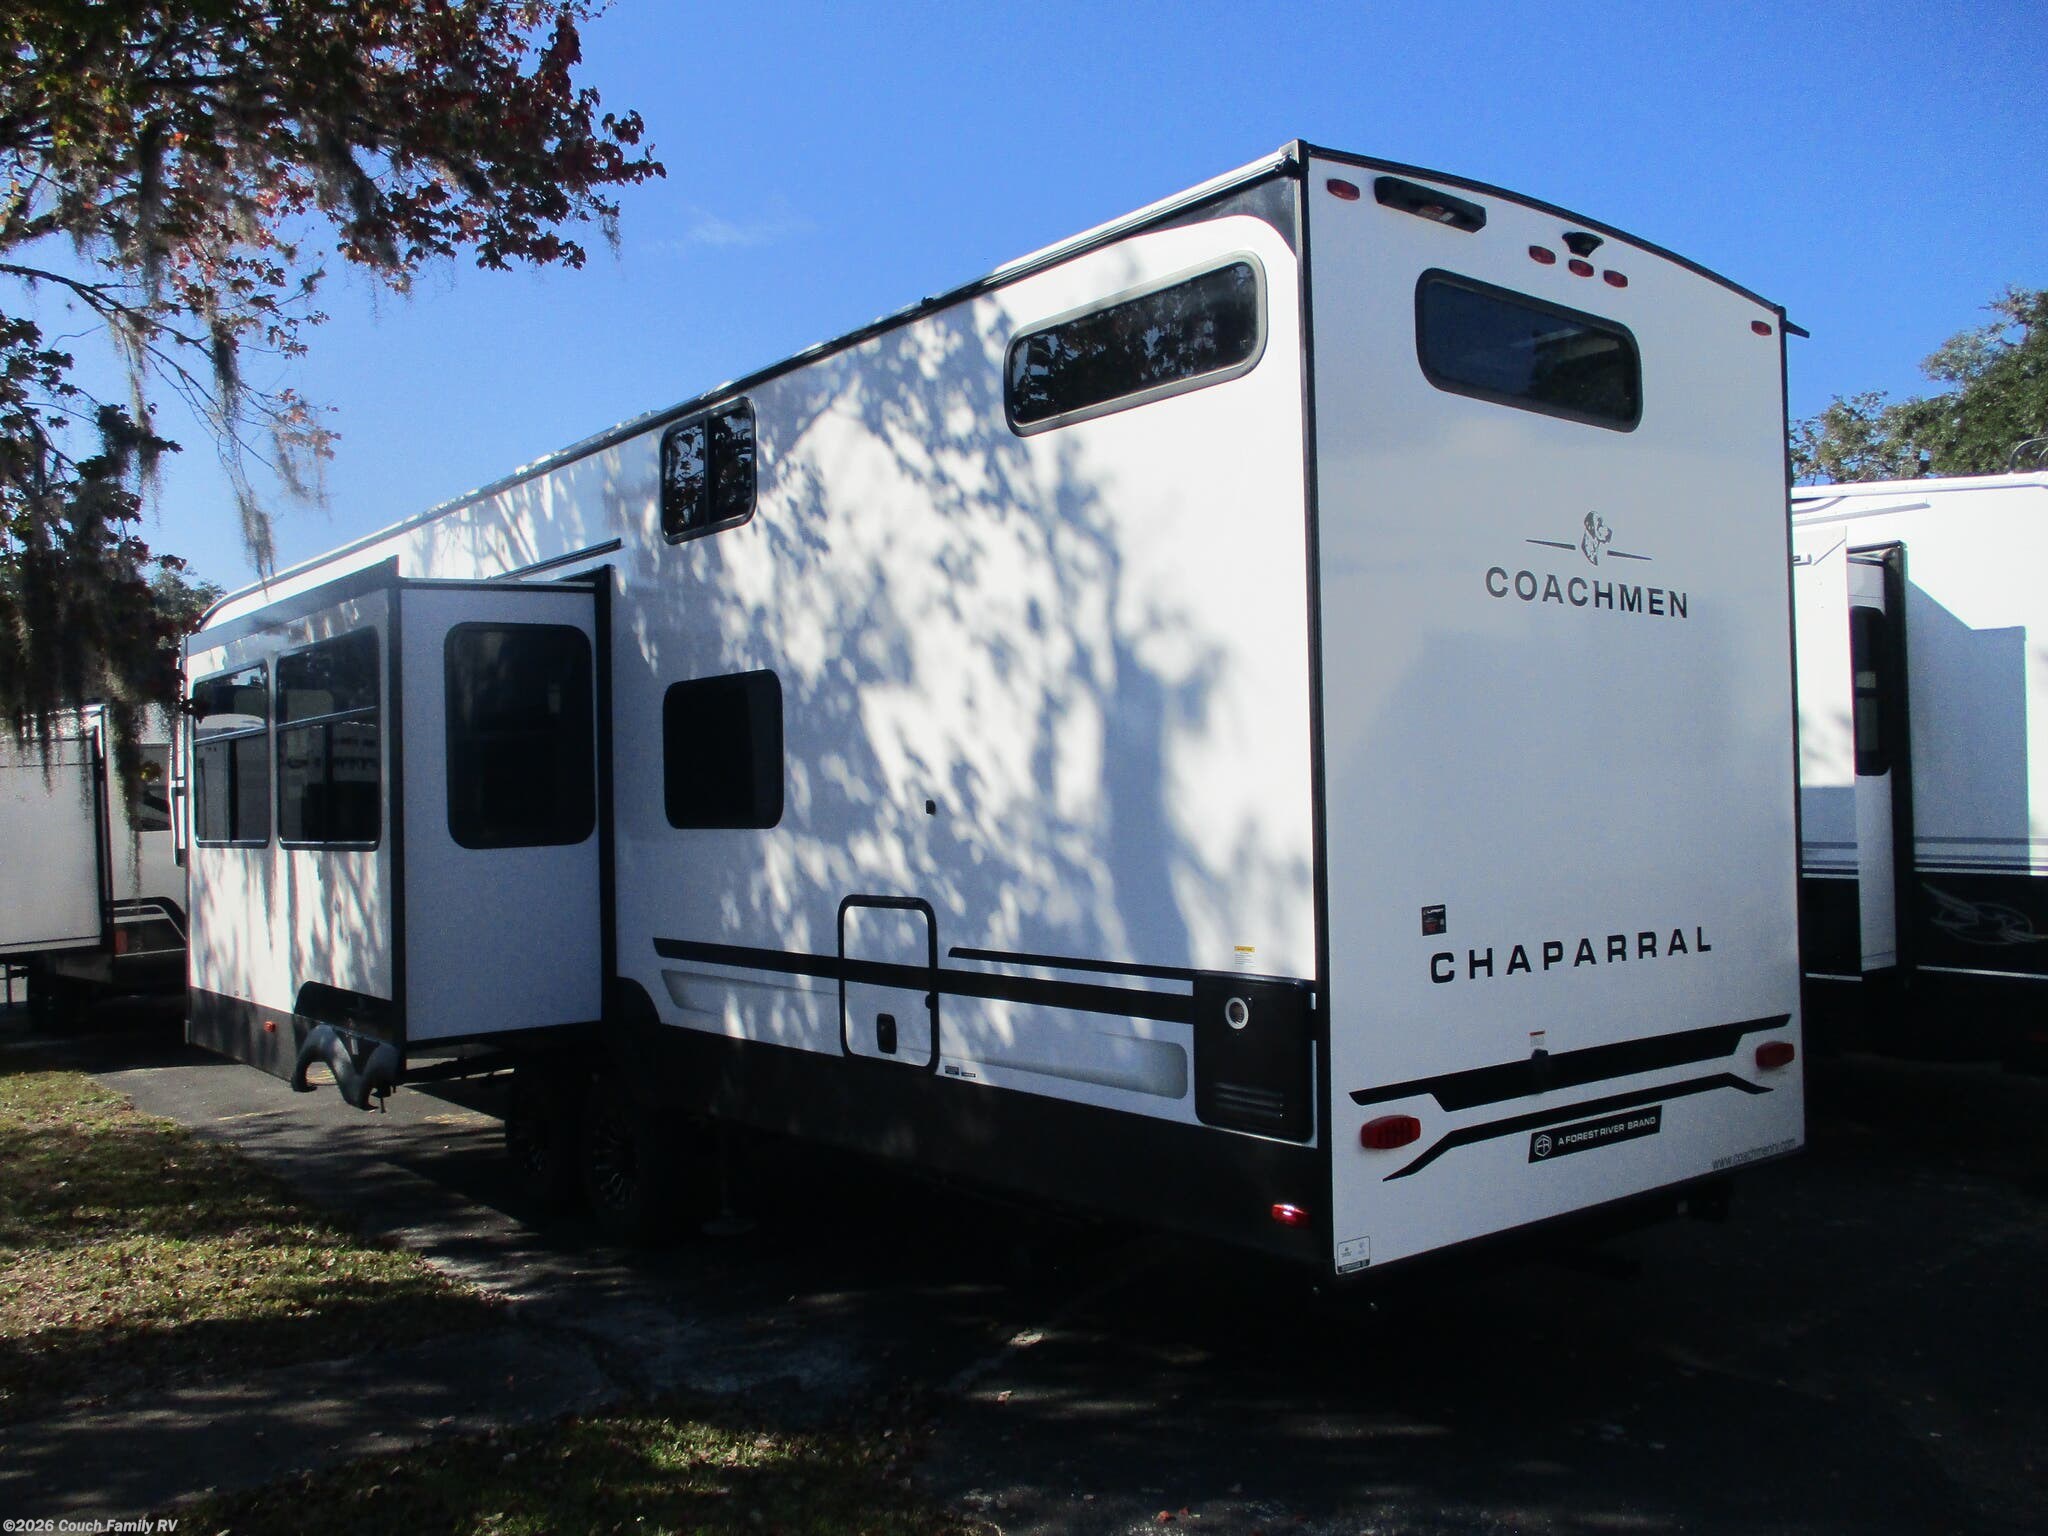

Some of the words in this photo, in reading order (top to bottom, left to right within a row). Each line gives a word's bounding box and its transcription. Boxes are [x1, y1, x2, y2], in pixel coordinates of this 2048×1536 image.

[1485, 566, 1688, 619] COACHMEN
[1430, 926, 1712, 984] CHAPARRAL
[1558, 1137, 1565, 1146] A
[1565, 1130, 1599, 1144] FOREST
[1600, 1123, 1625, 1136] RIVER
[1627, 1116, 1656, 1130] BRAND
